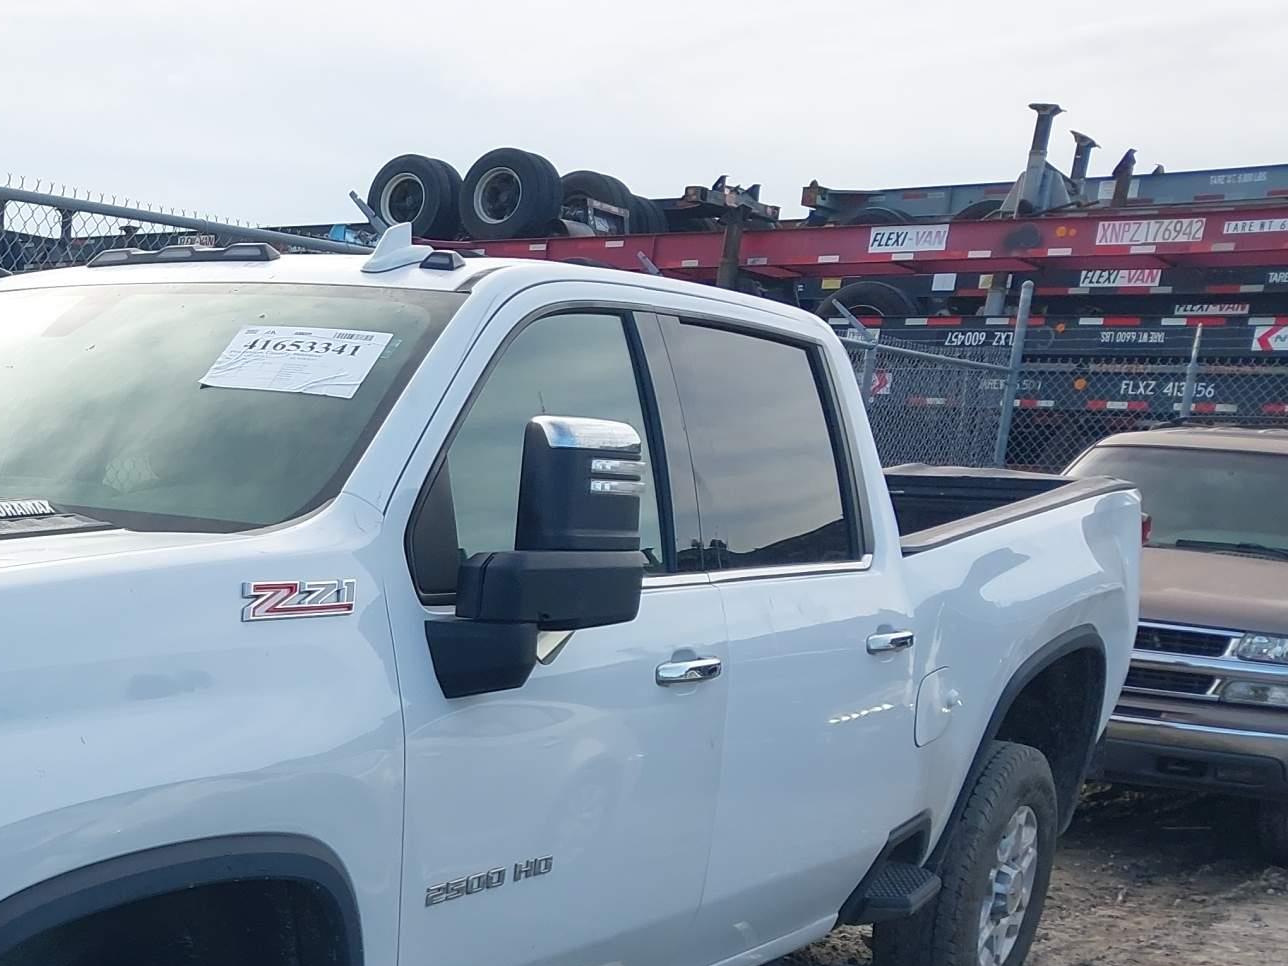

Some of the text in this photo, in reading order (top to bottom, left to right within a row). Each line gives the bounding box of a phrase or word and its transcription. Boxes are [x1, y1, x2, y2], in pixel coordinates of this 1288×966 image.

[1099, 219, 1205, 244] XNPZ176942
[1226, 221, 1255, 233] TARE
[870, 229, 947, 248] FLEXI-VAN
[1081, 269, 1159, 286] FLEXI-VAN
[243, 338, 361, 357] 41653341
[992, 331, 1014, 346] LXZ
[1120, 380, 1215, 398] FLXZ 41356
[241, 579, 356, 622] Z71
[424, 854, 553, 908] 2500 HD
